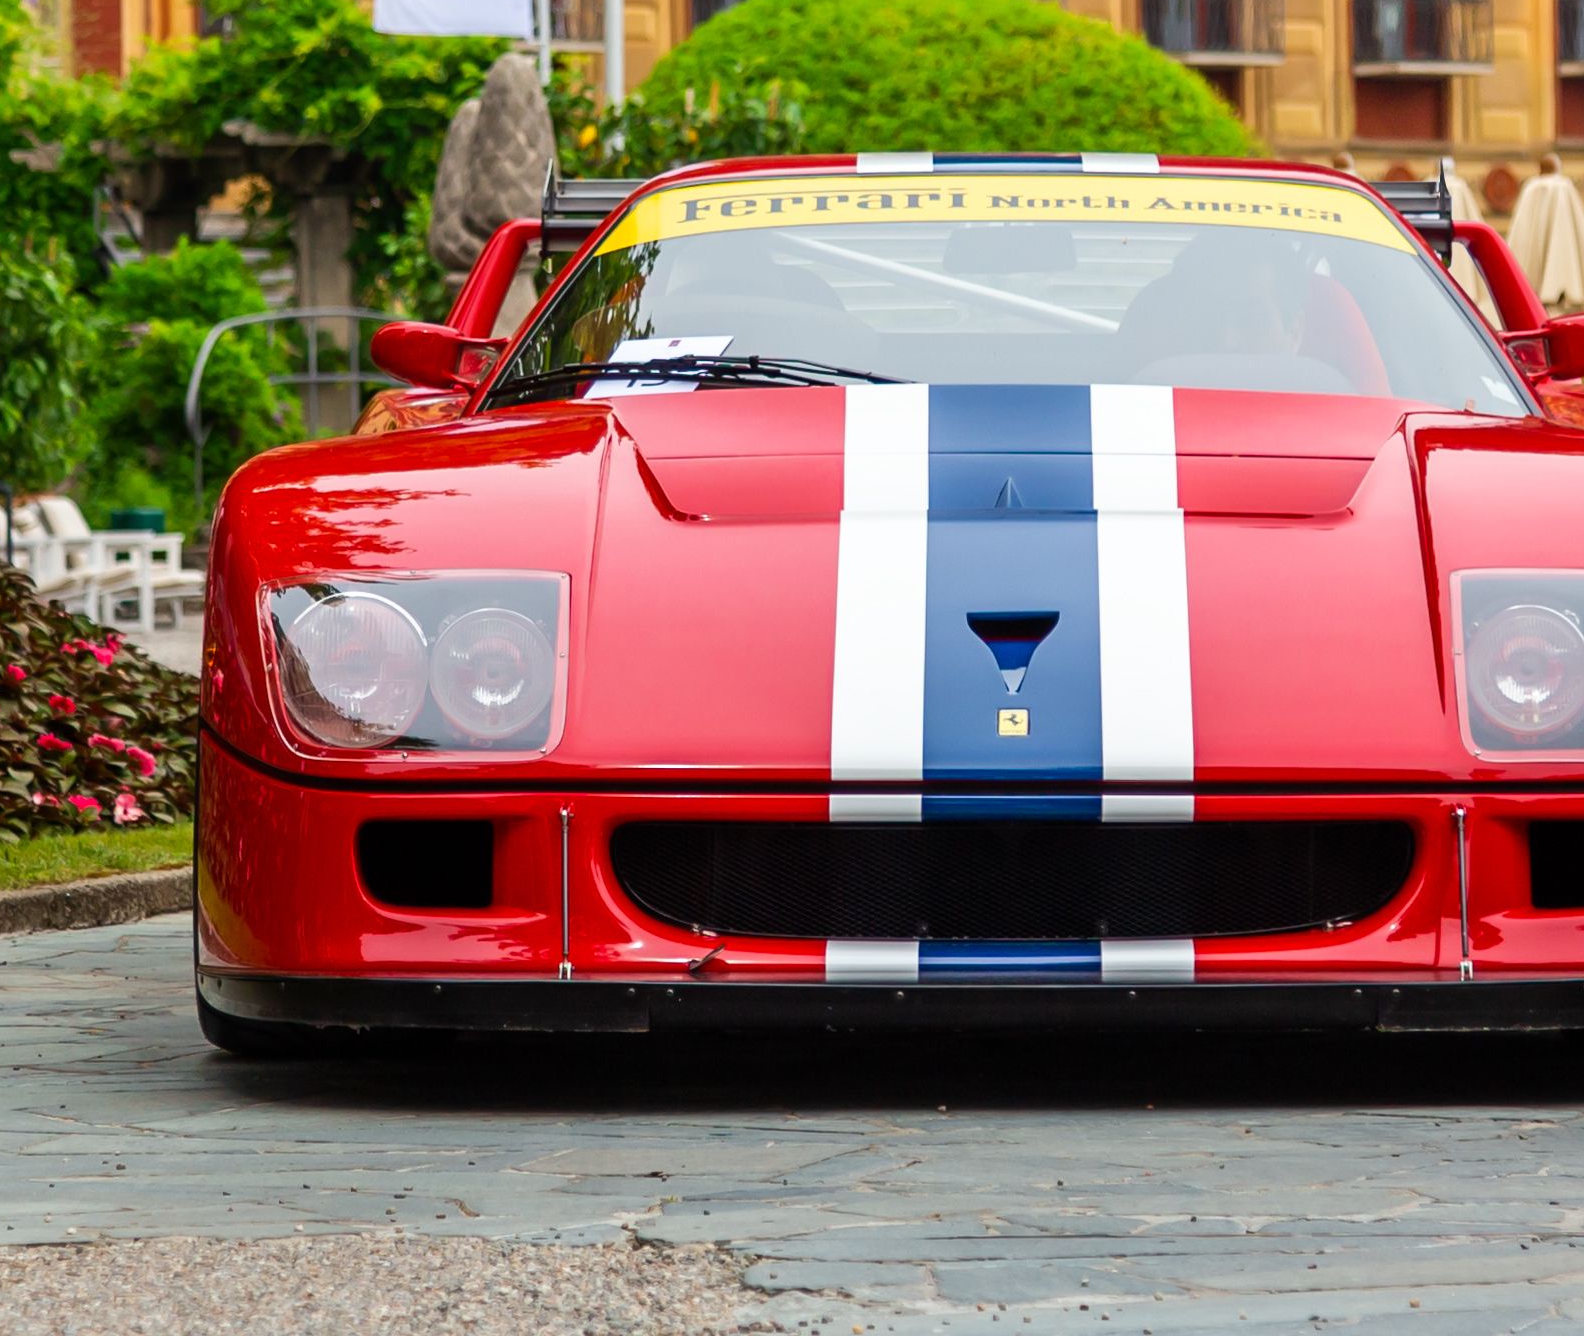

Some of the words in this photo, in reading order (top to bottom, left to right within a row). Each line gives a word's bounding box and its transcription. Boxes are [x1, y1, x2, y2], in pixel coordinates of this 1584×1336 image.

[677, 188, 968, 223] Ferrari
[986, 195, 1130, 209] North
[1144, 197, 1343, 223] America
